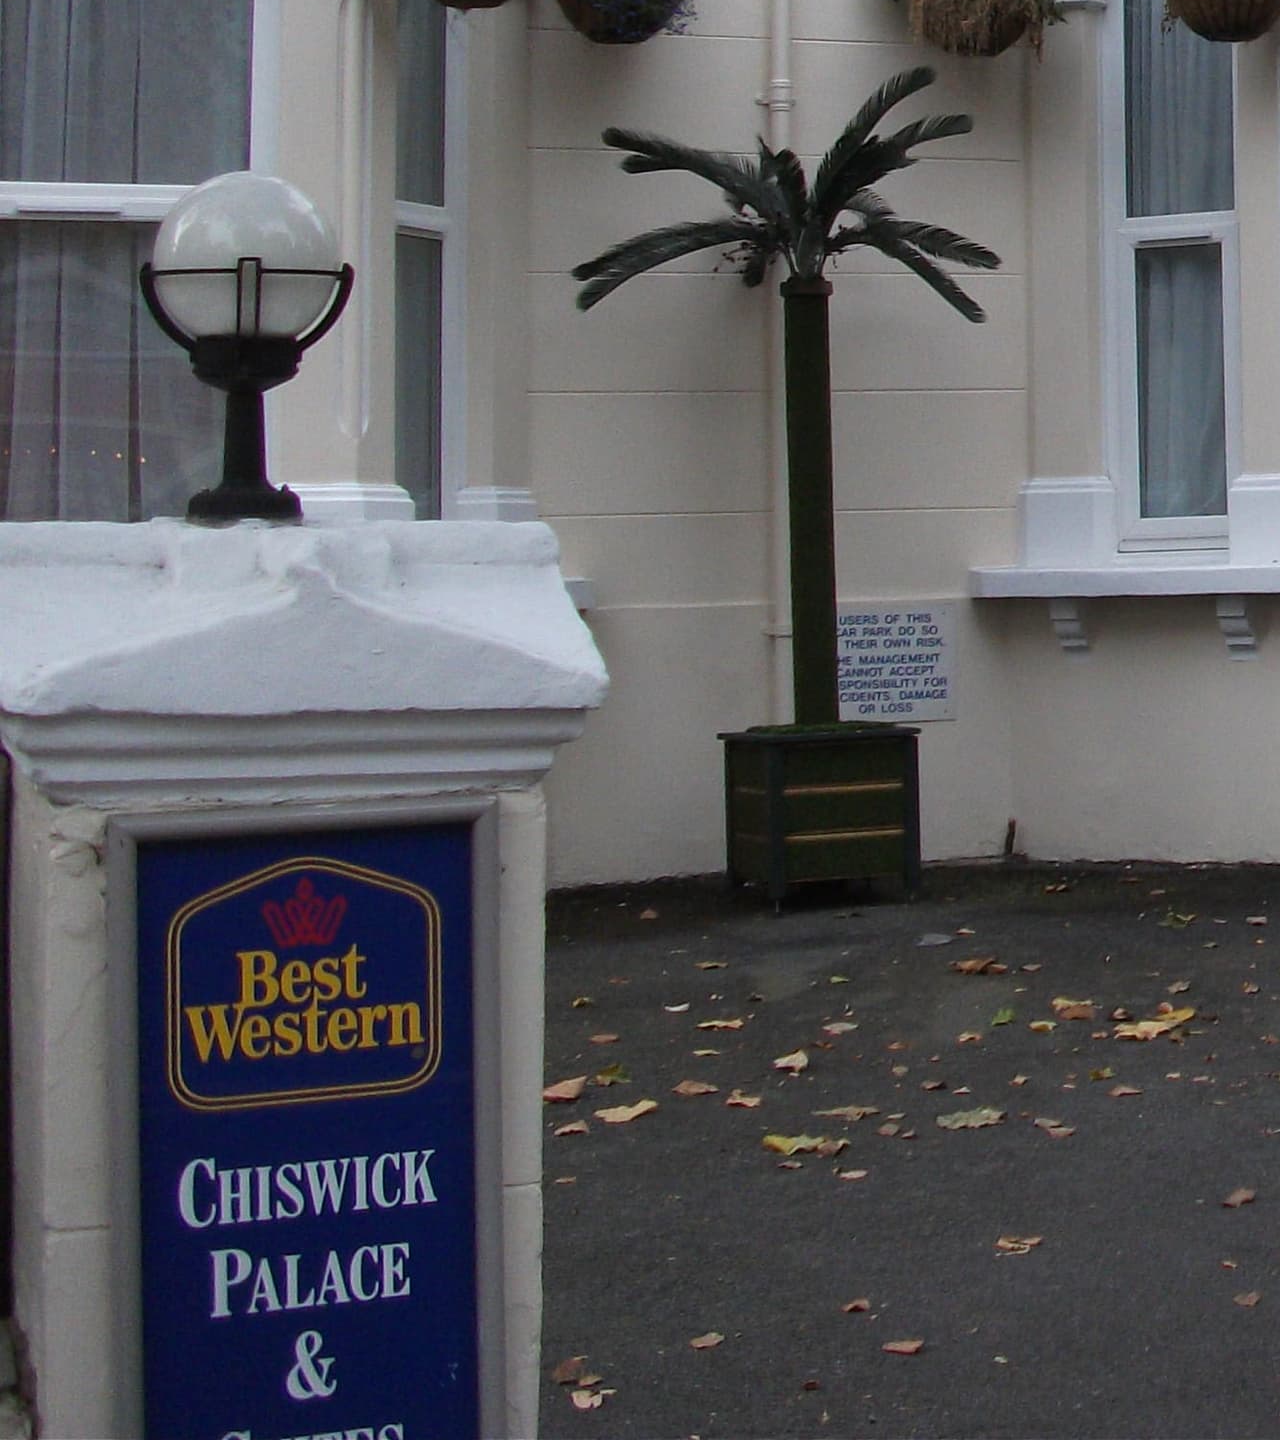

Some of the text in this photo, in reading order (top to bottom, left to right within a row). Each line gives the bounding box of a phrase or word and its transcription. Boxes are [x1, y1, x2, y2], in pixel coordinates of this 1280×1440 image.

[839, 613, 932, 626] USERS OF THIS
[863, 627, 892, 637] PARK
[898, 626, 916, 636] DO
[921, 625, 938, 635] SO
[845, 639, 878, 649] THEIR
[883, 638, 911, 649] OWN
[837, 653, 940, 666] HE MANAGEMENT
[890, 665, 935, 676] ACCEPT
[839, 677, 948, 690] SPONSIBILITY FOR
[899, 689, 948, 700] DAMAGE
[858, 702, 913, 714] OR LOSS
[235, 942, 367, 1009] Best
[184, 986, 426, 1064] Western
[178, 1148, 438, 1229] CHISWICK
[209, 1242, 411, 1320] PALACE
[286, 1329, 338, 1400] &
